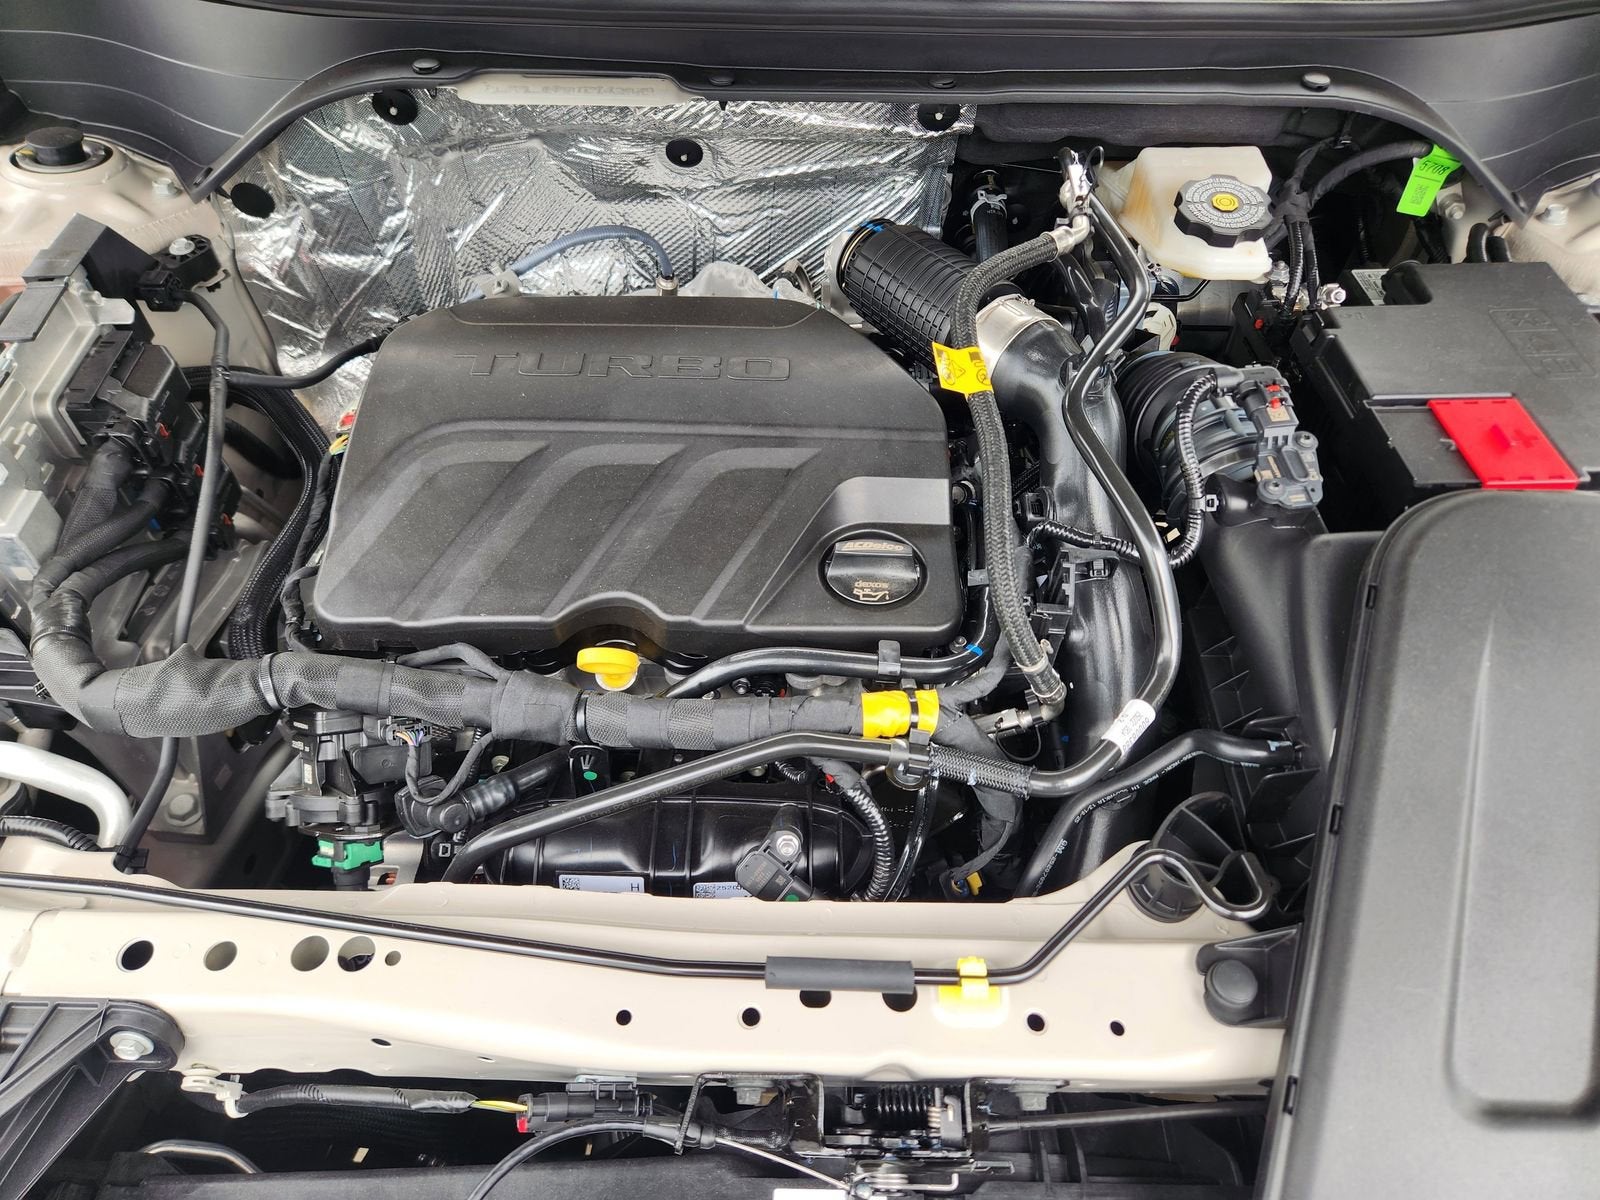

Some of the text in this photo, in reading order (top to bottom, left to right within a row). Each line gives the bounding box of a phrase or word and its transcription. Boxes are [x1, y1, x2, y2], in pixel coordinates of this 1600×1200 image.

[1419, 160, 1451, 175] 5708
[453, 352, 791, 381] TURBO
[842, 542, 904, 551] ACDelco
[854, 580, 890, 588] dexos
[631, 882, 640, 893] H
